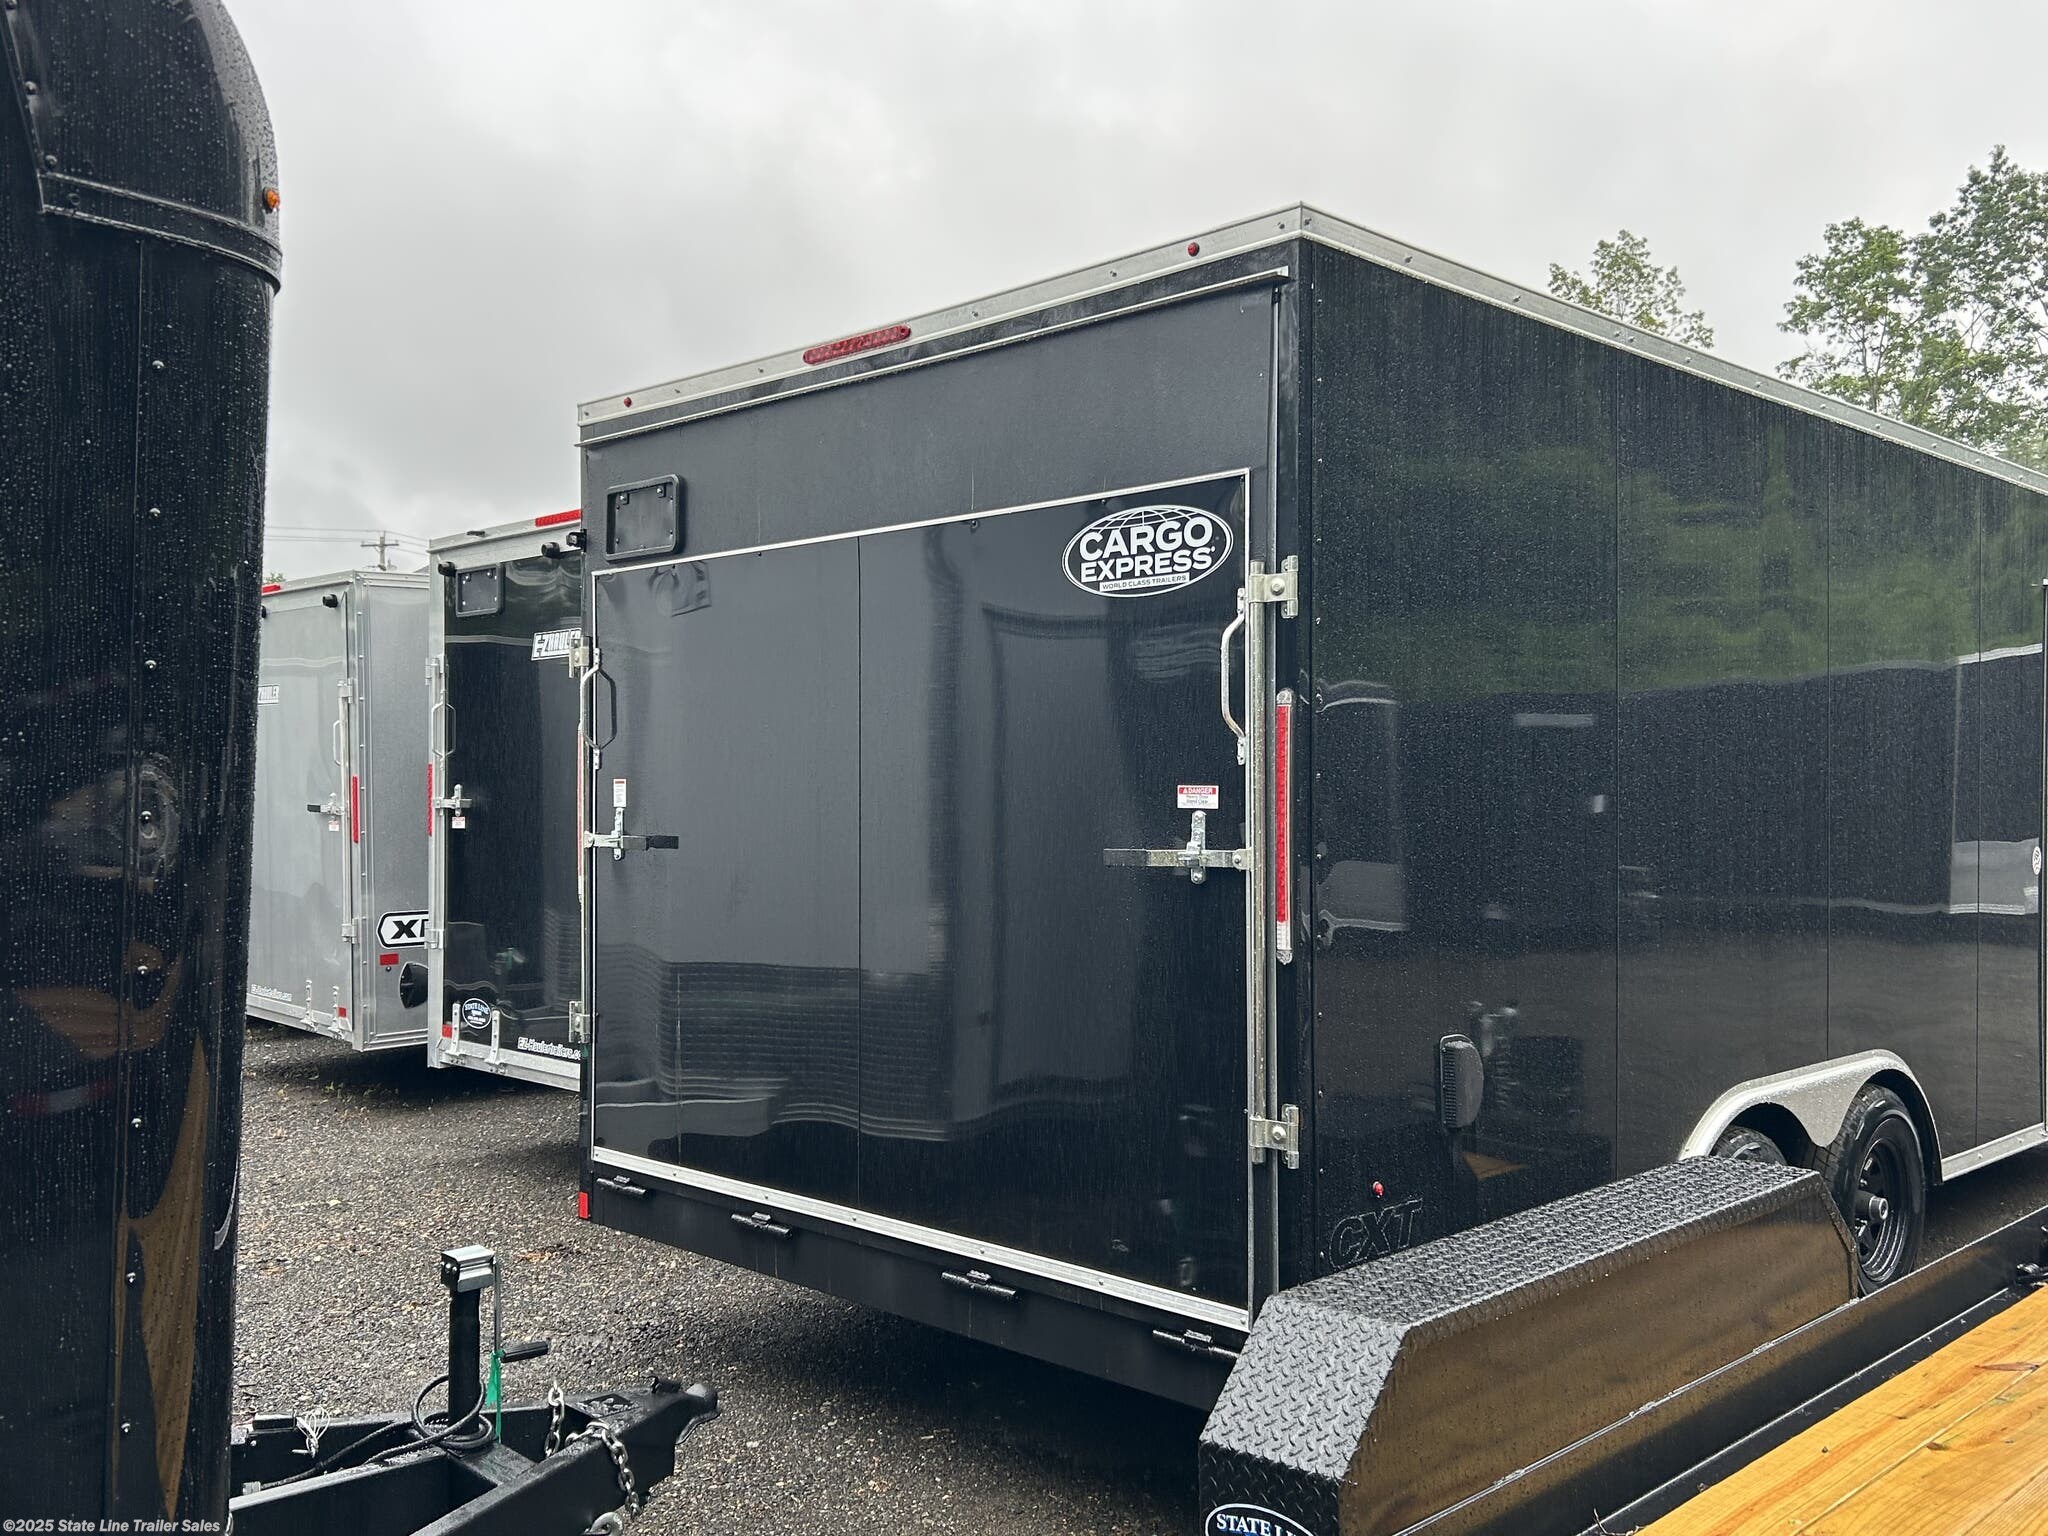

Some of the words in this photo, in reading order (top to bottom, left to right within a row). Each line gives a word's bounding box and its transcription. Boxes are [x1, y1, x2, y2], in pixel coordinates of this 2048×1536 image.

[1079, 516, 1213, 561] CARGO
[1081, 547, 1212, 583] EXPRESS
[1102, 580, 1128, 590] WORLD
[1128, 578, 1151, 587] CLASS
[1152, 574, 1187, 585] TRAILERS
[1187, 786, 1212, 794] DANGER
[1216, 1514, 1271, 1536] STATE
